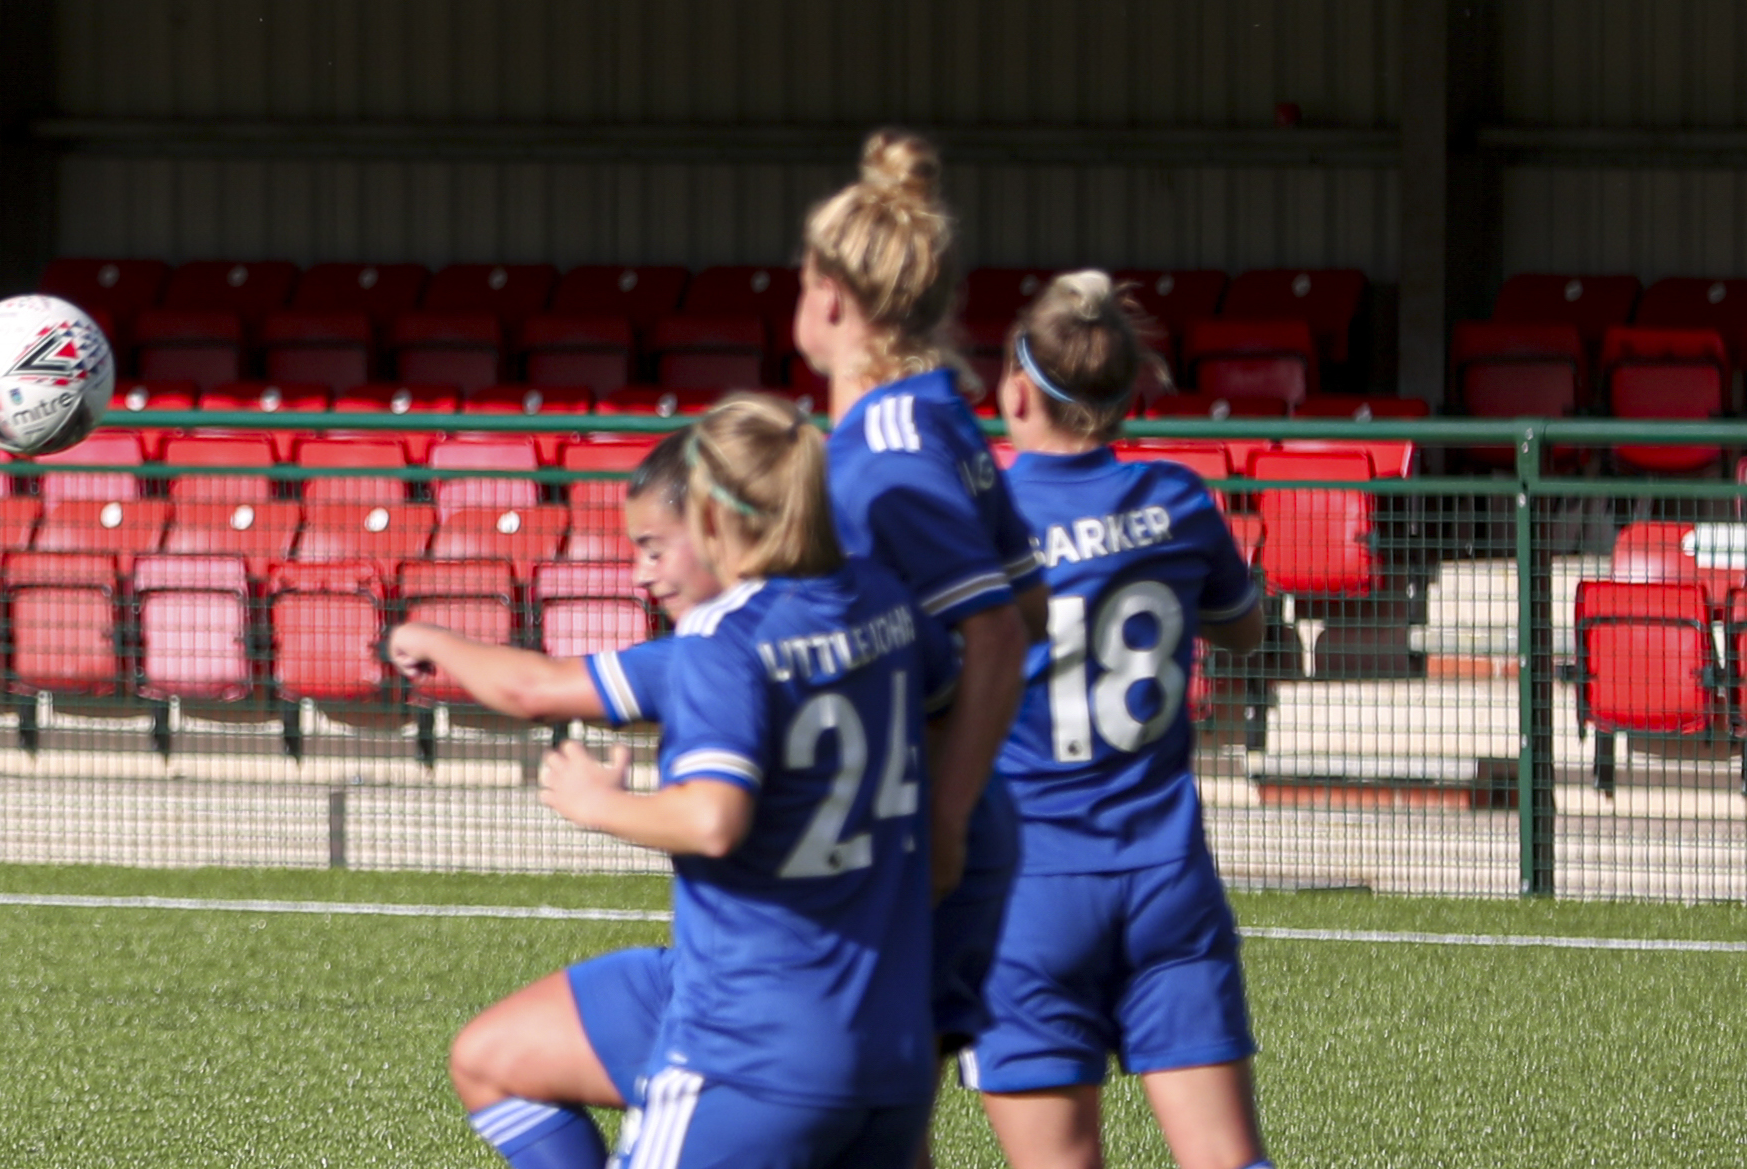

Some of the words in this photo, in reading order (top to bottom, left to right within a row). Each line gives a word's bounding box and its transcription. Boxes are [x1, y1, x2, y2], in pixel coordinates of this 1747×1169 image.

[11, 391, 73, 425] mitre
[1047, 580, 1185, 762] 18
[779, 670, 919, 878] 24
